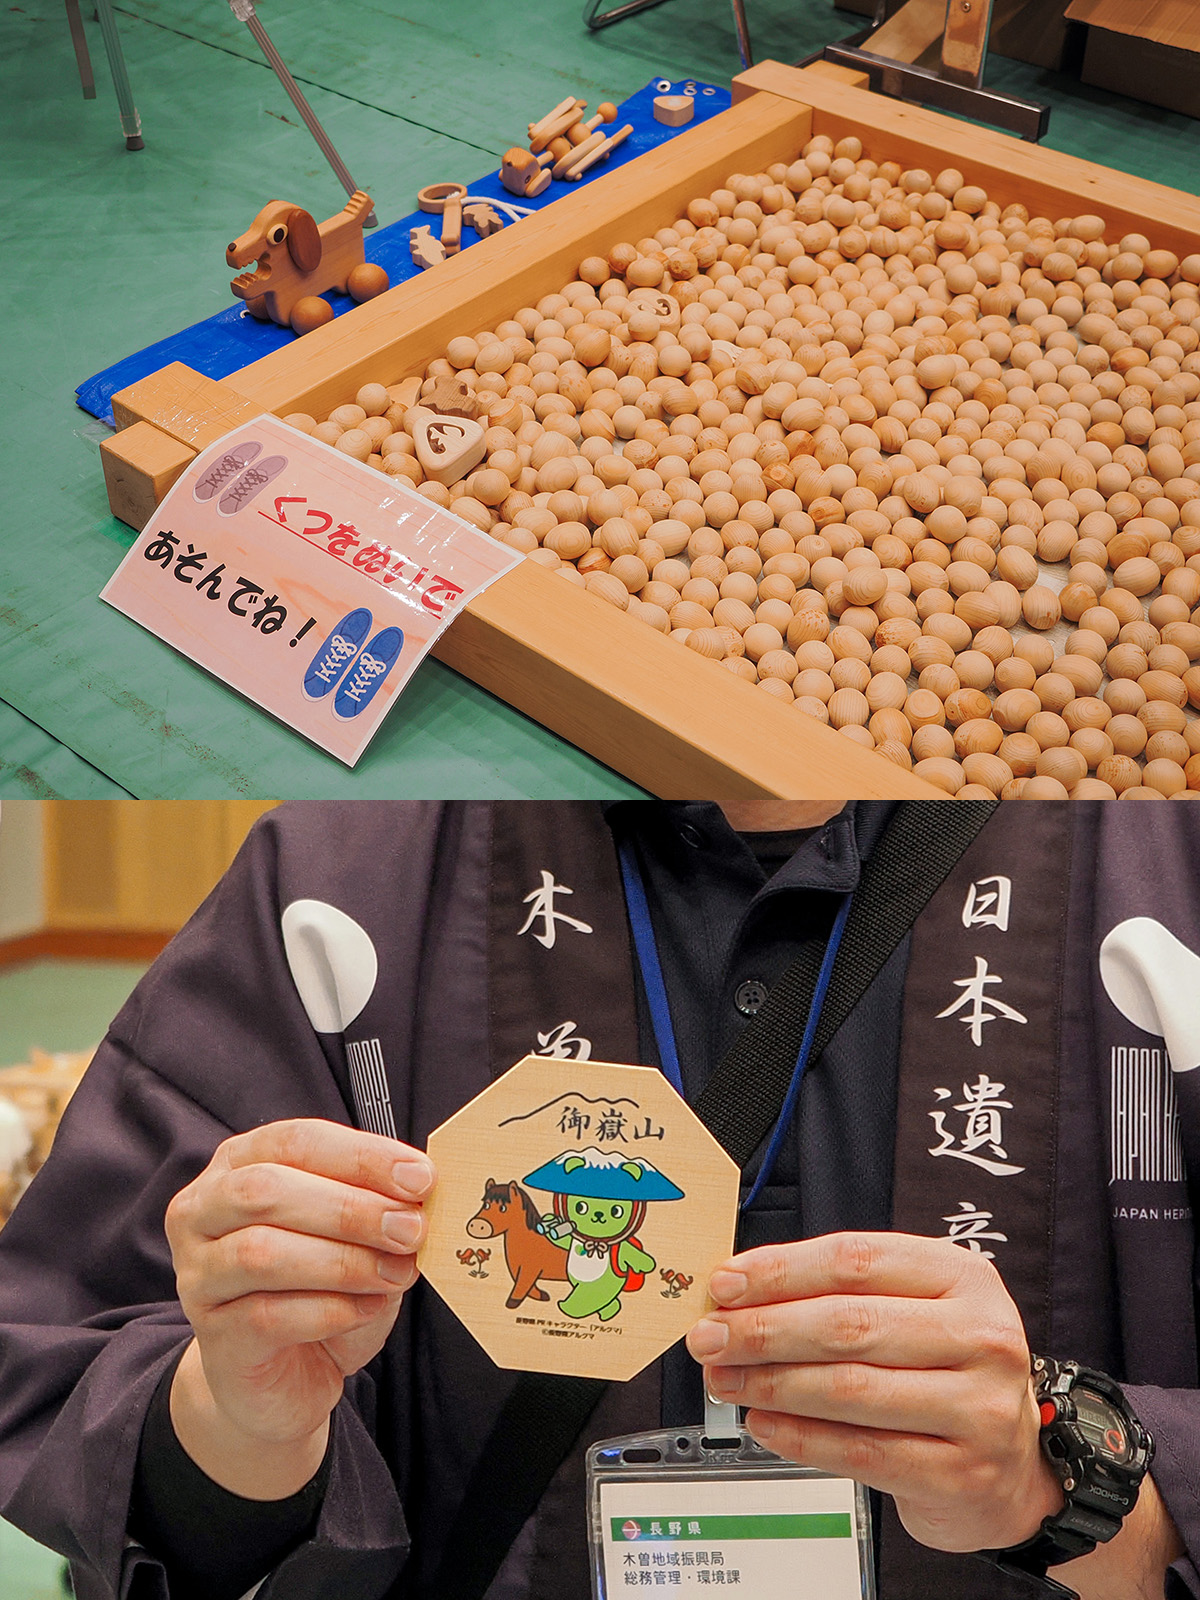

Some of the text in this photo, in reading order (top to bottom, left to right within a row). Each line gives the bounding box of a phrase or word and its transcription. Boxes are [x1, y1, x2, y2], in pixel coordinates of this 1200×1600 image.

[274, 495, 465, 612] くつをぬいで
[556, 1105, 665, 1143] 御嶽山
[1113, 1206, 1159, 1220] JAPAN
[1088, 1484, 1130, 1507] G-SHOCK
[650, 1521, 702, 1536] 長野県
[622, 1551, 725, 1567] 木曽地域振興局
[623, 1569, 742, 1586] 総務管理・環境課
